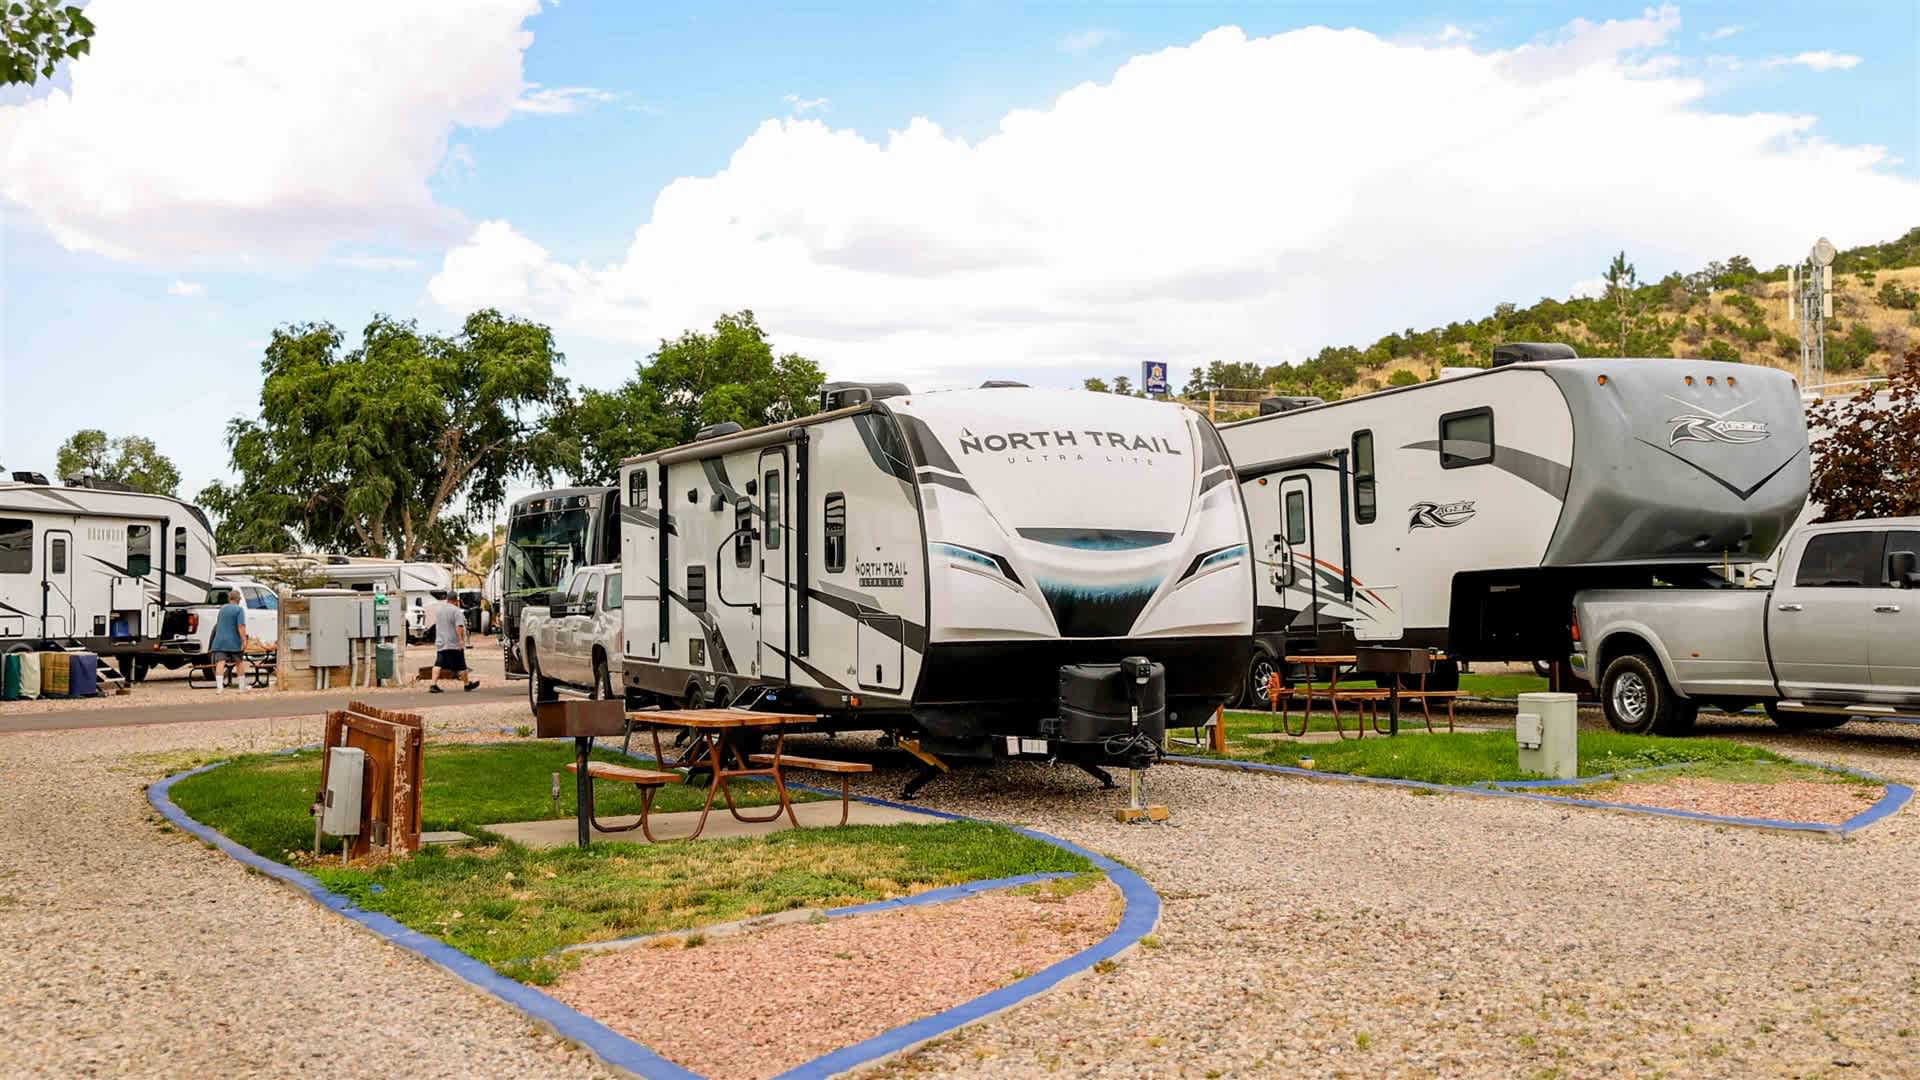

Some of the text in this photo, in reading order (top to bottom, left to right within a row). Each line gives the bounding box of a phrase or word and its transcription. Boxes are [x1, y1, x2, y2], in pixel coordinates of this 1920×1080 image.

[959, 429, 1182, 456] NORTH TRAIL
[1007, 454, 1153, 466] ULTRA LITE
[855, 559, 909, 577] NORTH TRAIL
